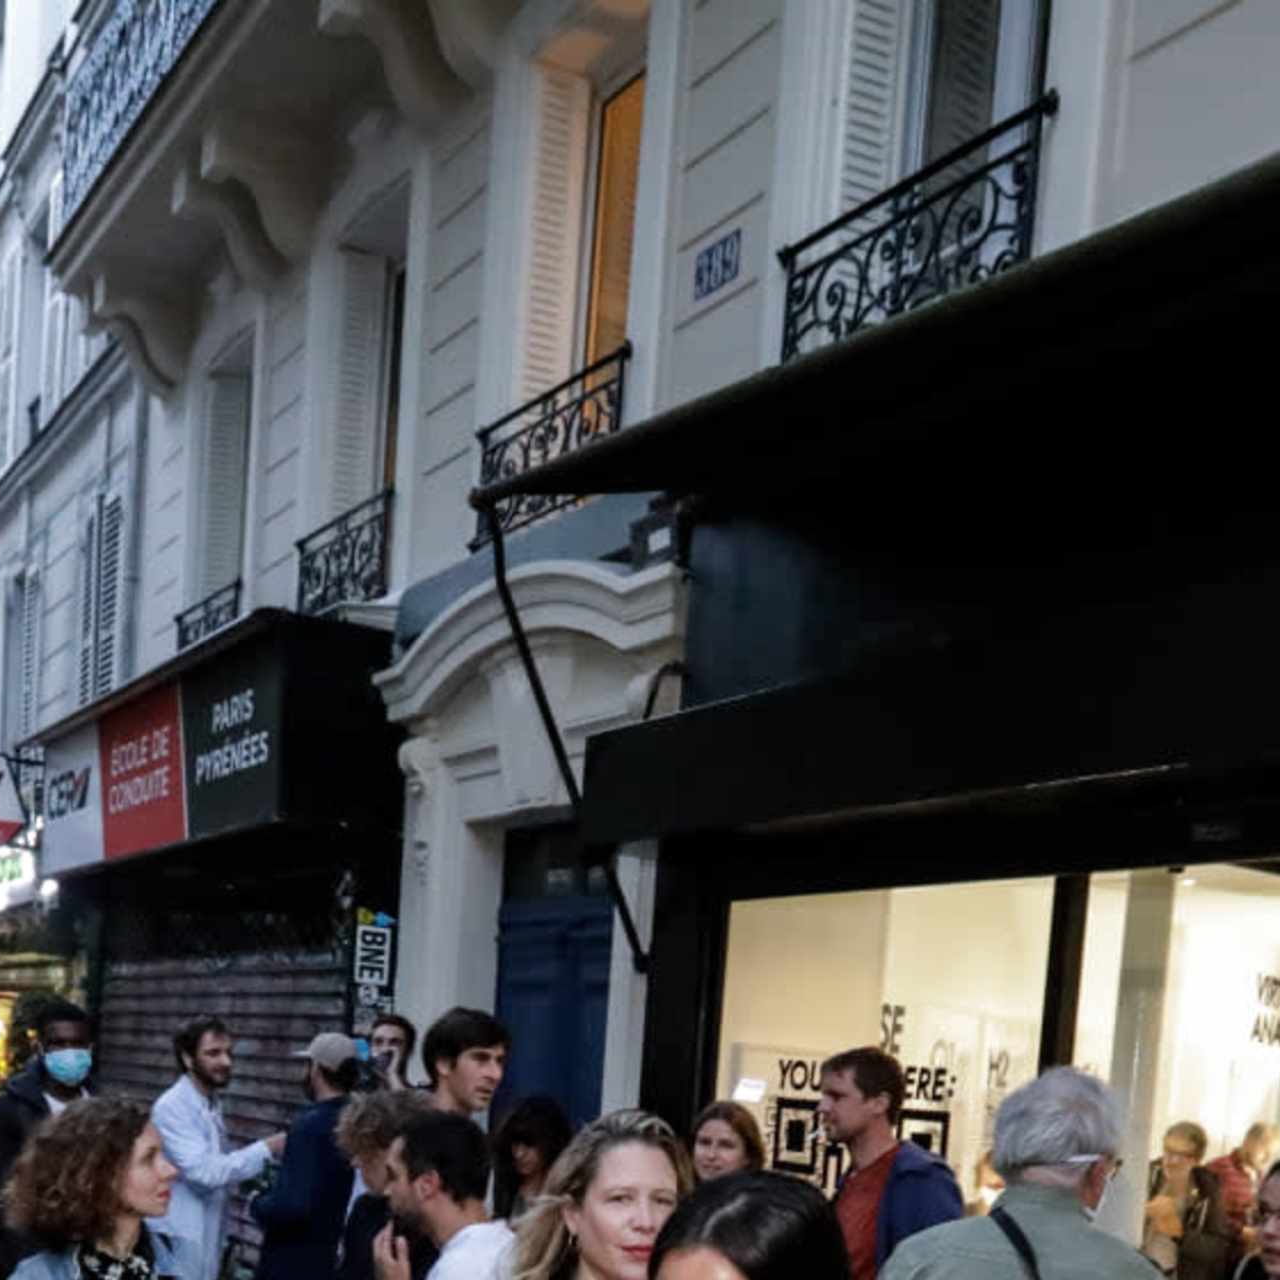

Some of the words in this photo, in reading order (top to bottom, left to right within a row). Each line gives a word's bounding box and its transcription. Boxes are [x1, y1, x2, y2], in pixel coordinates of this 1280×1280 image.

[211, 688, 255, 734] PARIS
[151, 726, 171, 761] DE
[195, 729, 270, 786] PYRÉNÉES
[48, 768, 78, 821] CER
[108, 765, 171, 815] CONDUITE
[359, 929, 388, 982] BNE
[904, 1064, 957, 1102] ERE:
